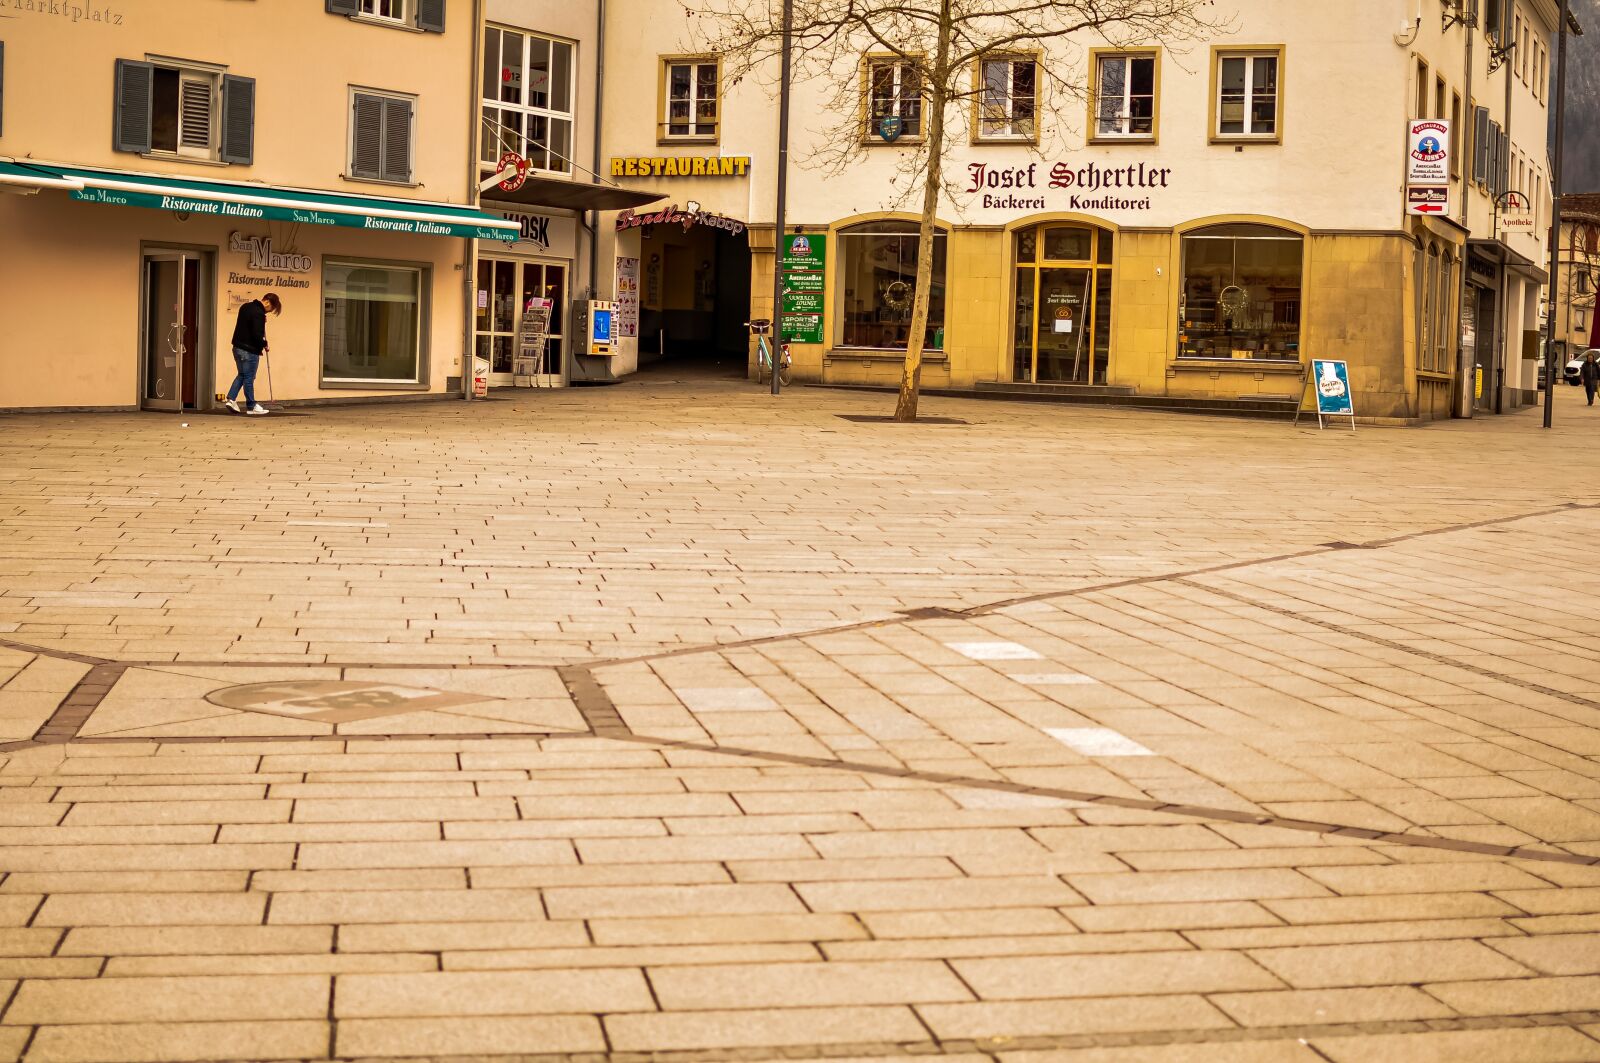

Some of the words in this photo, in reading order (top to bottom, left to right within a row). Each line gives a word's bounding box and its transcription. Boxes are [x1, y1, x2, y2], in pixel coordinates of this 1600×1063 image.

[1415, 123, 1447, 133] RESTAURANT
[498, 154, 520, 171] TABAK
[611, 157, 749, 177] RESTAURANT
[966, 162, 1037, 193] Josef
[1048, 161, 1171, 192] Schertler
[97, 189, 127, 204] Marco
[983, 195, 1045, 209] Bäckerei
[1070, 195, 1151, 210] Konditorei
[161, 196, 218, 213] Ristorante
[221, 201, 263, 218] Italiano
[293, 210, 309, 223] San
[310, 211, 335, 225] Marco
[364, 216, 413, 233] Ristorante
[415, 221, 451, 235] Italiano
[1502, 218, 1533, 228] Apotheke
[476, 227, 490, 239] San
[490, 228, 514, 240] Marco
[503, 212, 550, 248] OSK
[230, 231, 253, 251] San
[249, 237, 312, 271] Marco
[228, 272, 273, 287] Ristorante
[275, 275, 310, 289] Italiano
